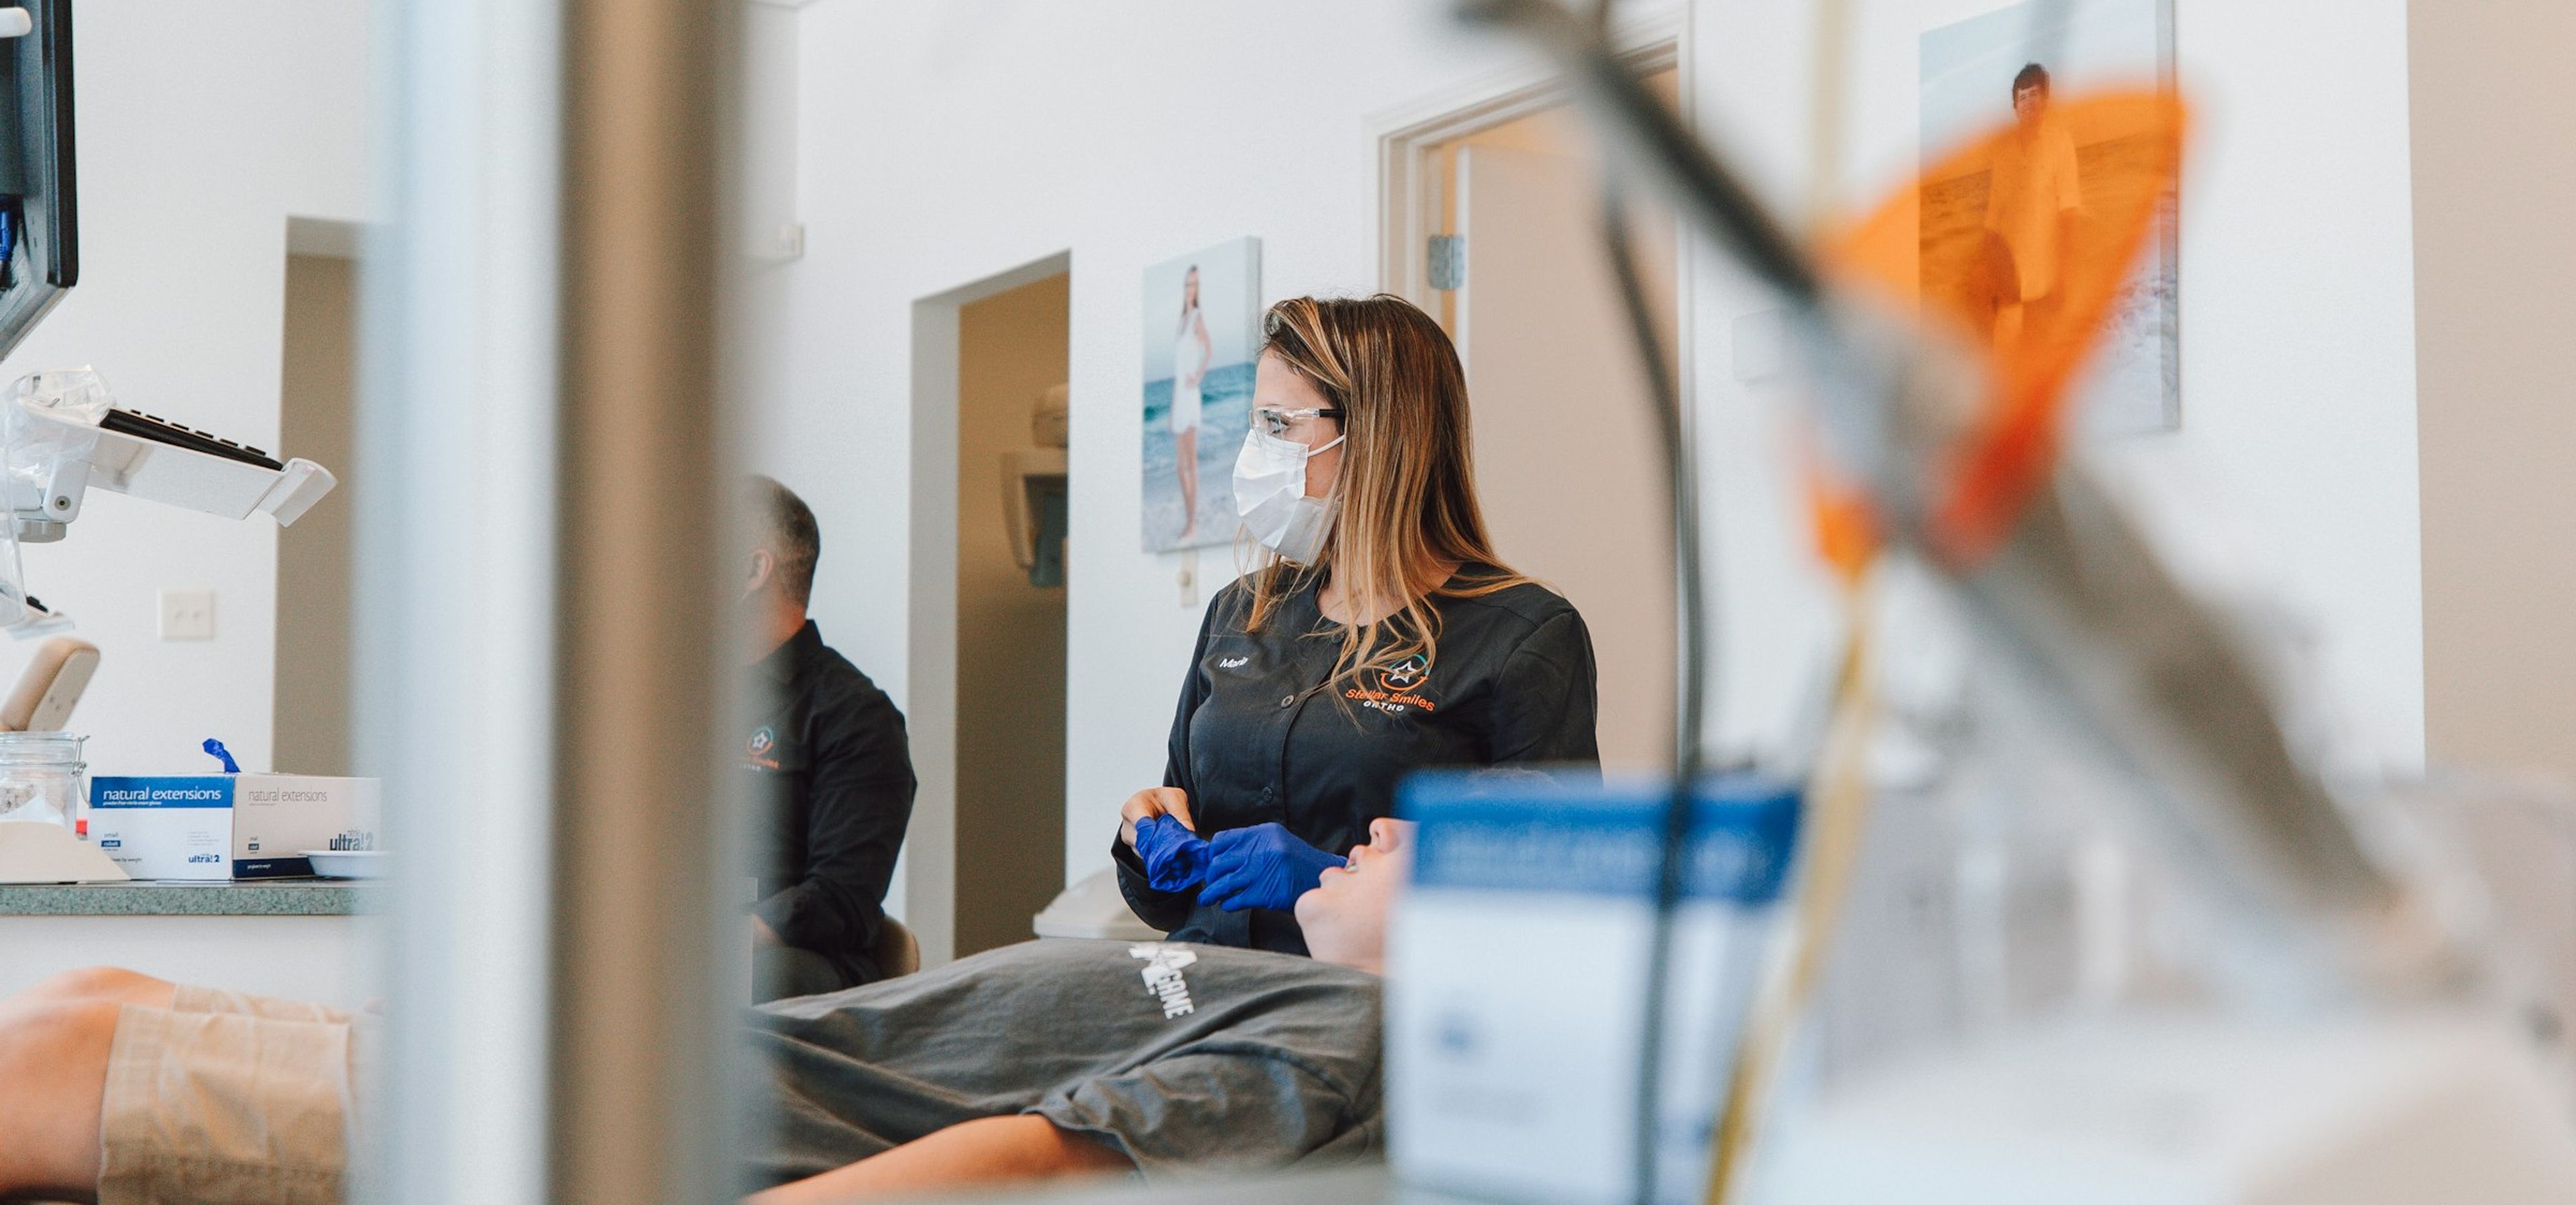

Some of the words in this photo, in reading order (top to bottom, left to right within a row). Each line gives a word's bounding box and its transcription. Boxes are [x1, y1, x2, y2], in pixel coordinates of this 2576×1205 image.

[1363, 700, 1405, 712] ORTHO
[1389, 692, 1435, 712] Smiles
[103, 786, 149, 800] natural
[152, 785, 221, 800] extensions
[248, 787, 279, 802] natural
[281, 787, 327, 802] extensions
